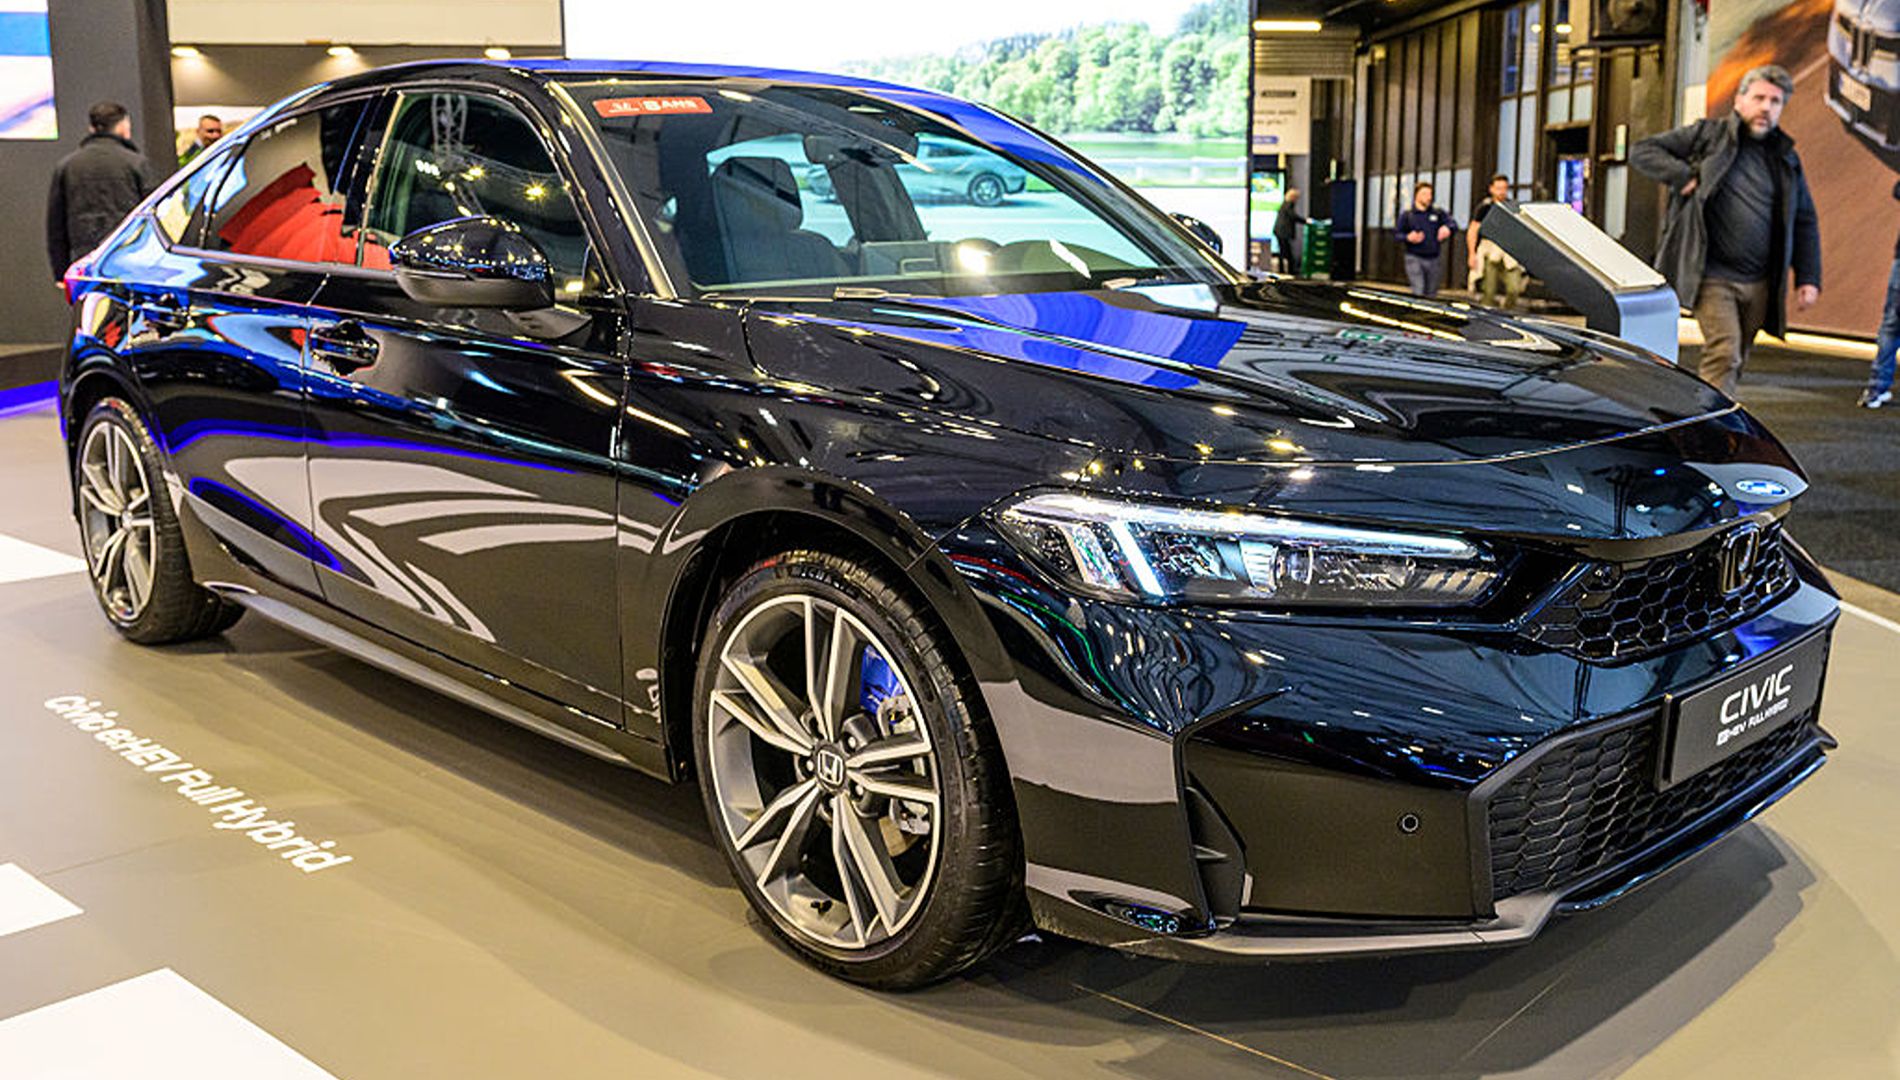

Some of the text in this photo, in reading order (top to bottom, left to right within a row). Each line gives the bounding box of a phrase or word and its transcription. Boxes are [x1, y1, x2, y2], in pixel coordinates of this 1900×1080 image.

[1720, 664, 1793, 724] CIVIC
[160, 768, 243, 805] Full
[209, 799, 353, 873] Hybrid
